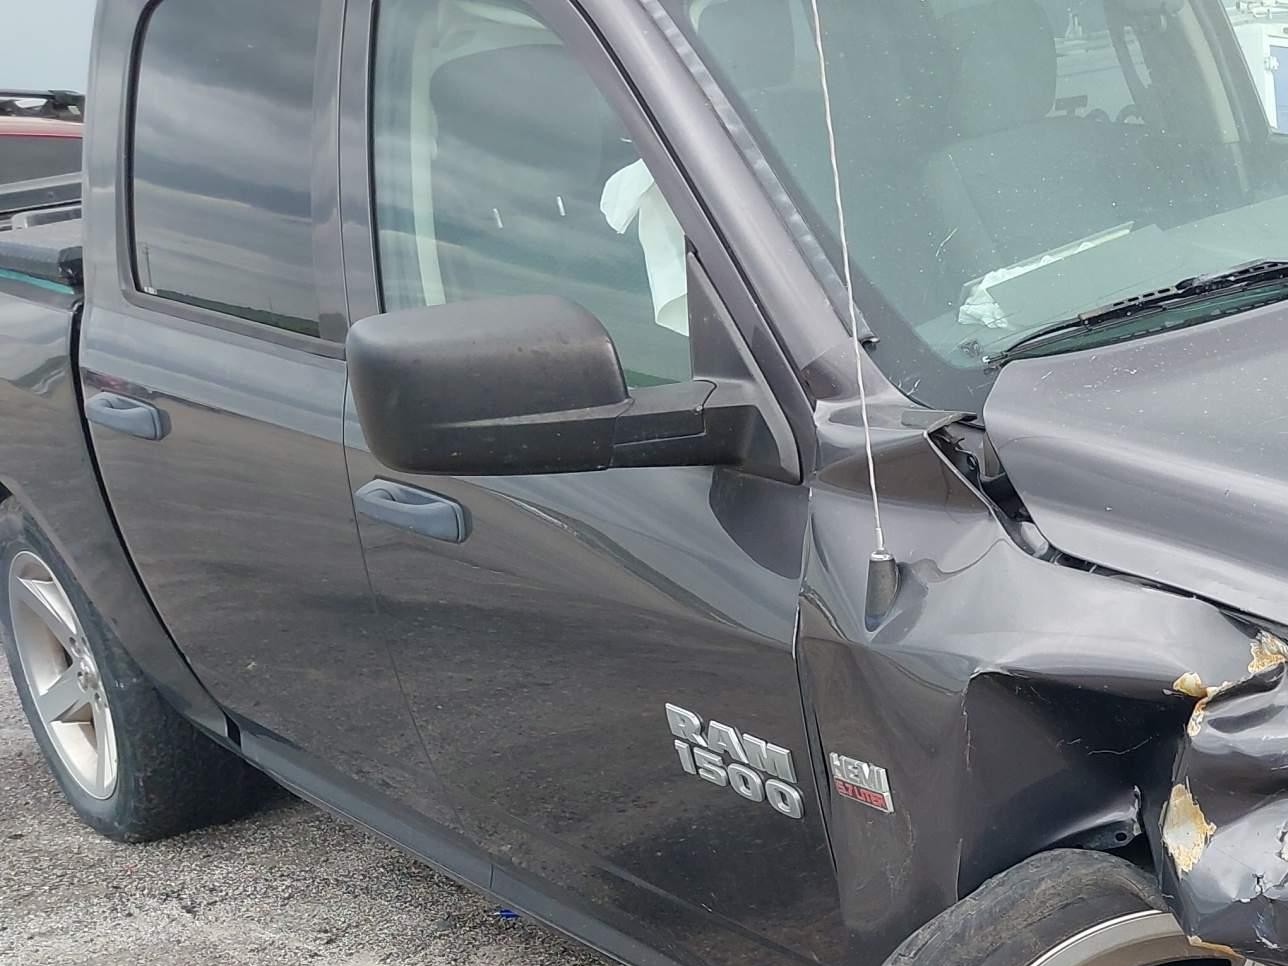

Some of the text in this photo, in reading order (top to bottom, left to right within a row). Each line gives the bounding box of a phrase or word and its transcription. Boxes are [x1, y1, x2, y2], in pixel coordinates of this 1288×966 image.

[664, 702, 798, 784] RAM
[674, 739, 804, 819] 1500
[829, 752, 890, 794] HEMI
